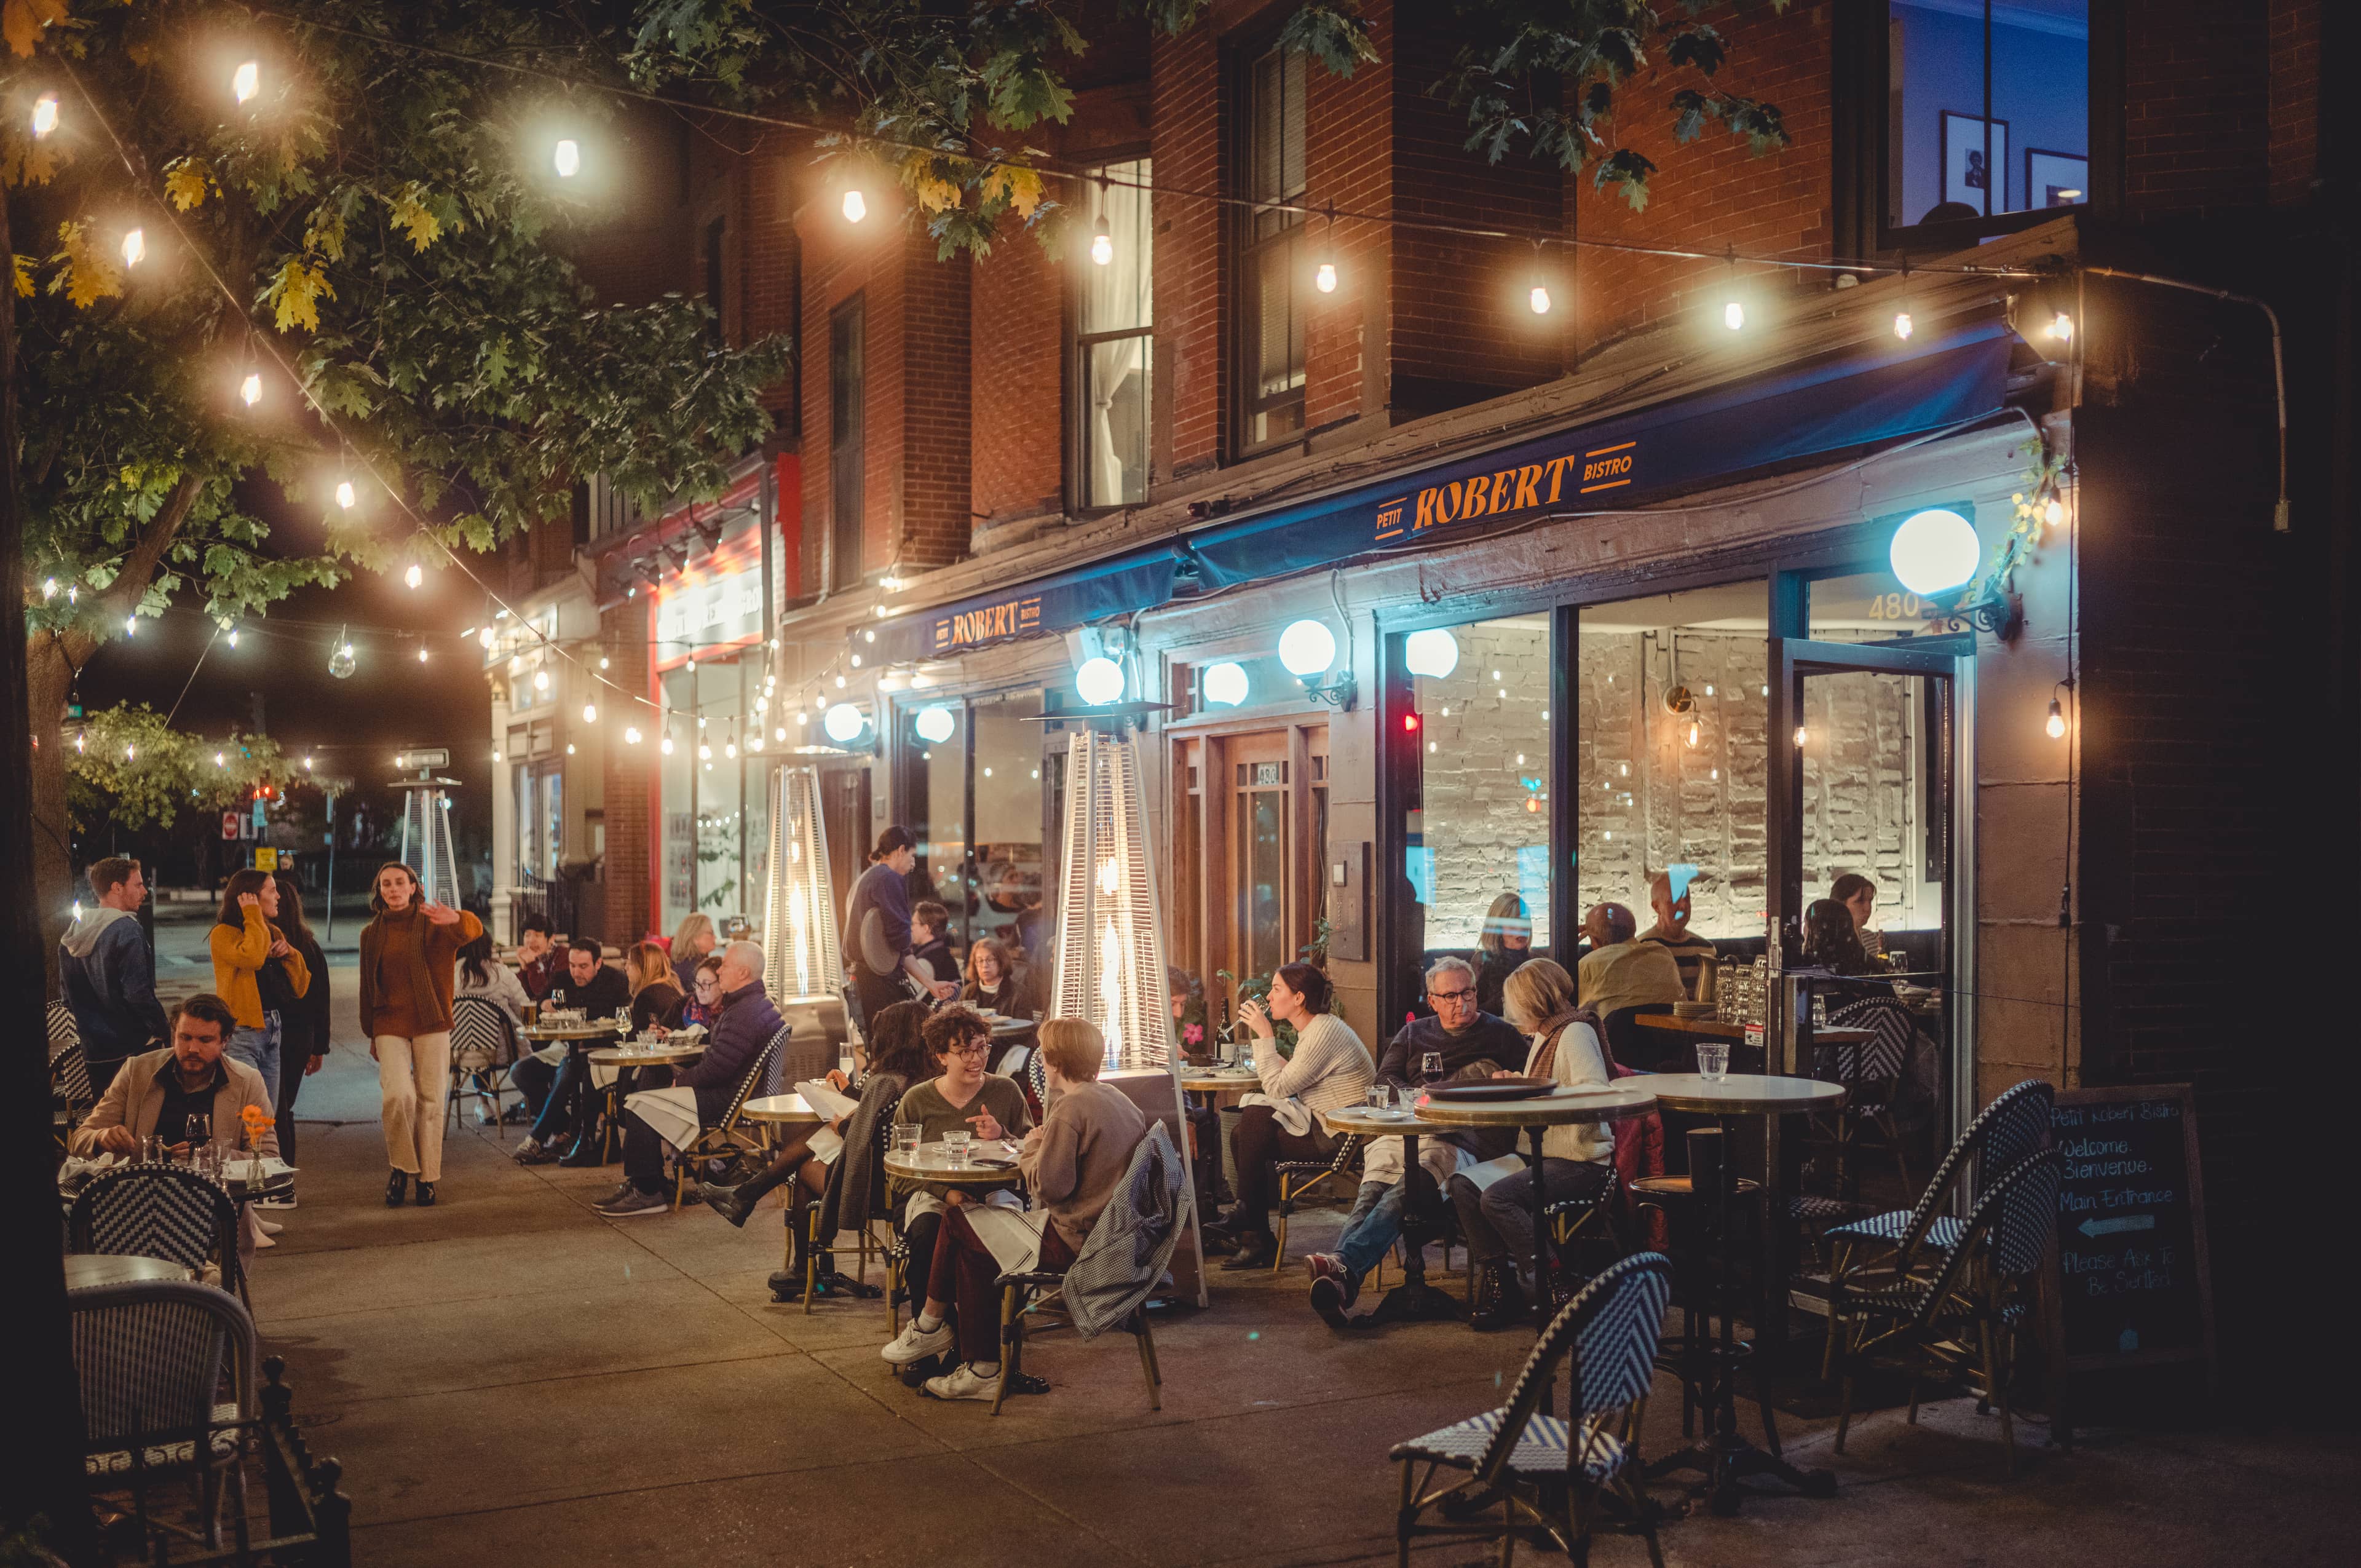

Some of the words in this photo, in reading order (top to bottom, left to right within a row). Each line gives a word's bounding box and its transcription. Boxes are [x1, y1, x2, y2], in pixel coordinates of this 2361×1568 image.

[1377, 507, 1403, 529] PETIT
[1412, 454, 1575, 531] ROBERT
[1584, 455, 1632, 481] BISTRO
[1869, 592, 1919, 620] 480
[951, 601, 1019, 644] ROBERT
[2050, 1106, 2084, 1128] Petit
[2060, 1190, 2098, 1212] Main
[2062, 1250, 2116, 1274] Please
